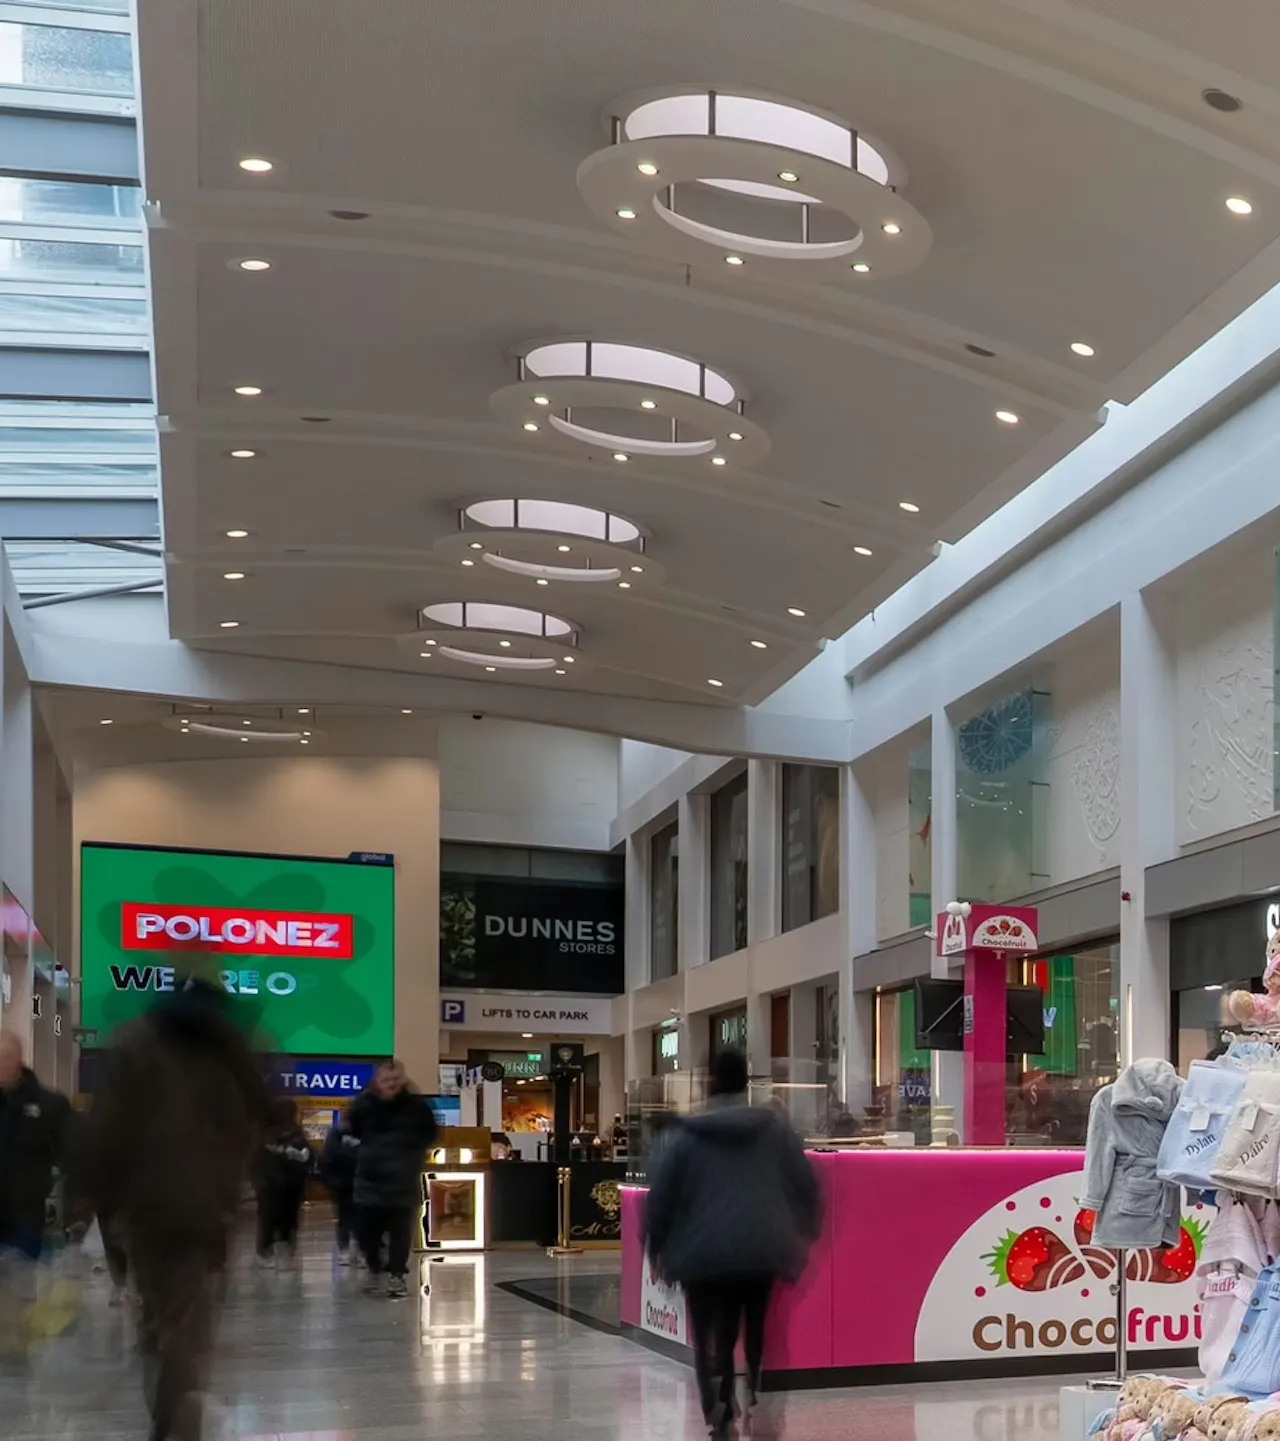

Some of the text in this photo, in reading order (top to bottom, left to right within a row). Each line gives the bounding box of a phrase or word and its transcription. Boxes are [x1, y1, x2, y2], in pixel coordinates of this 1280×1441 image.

[135, 912, 341, 949] POLONEZ
[484, 915, 616, 942] DUNNES
[559, 941, 616, 955] STORES
[981, 937, 1028, 949] Chocofruit
[109, 964, 176, 993] WE
[482, 1008, 589, 1021] LIFTS TO CAR PARK
[280, 1071, 363, 1090] TRAVEL
[1185, 1133, 1217, 1157] Dylan
[1239, 1132, 1270, 1166] Daire
[972, 1304, 1203, 1351] Chocofrui
